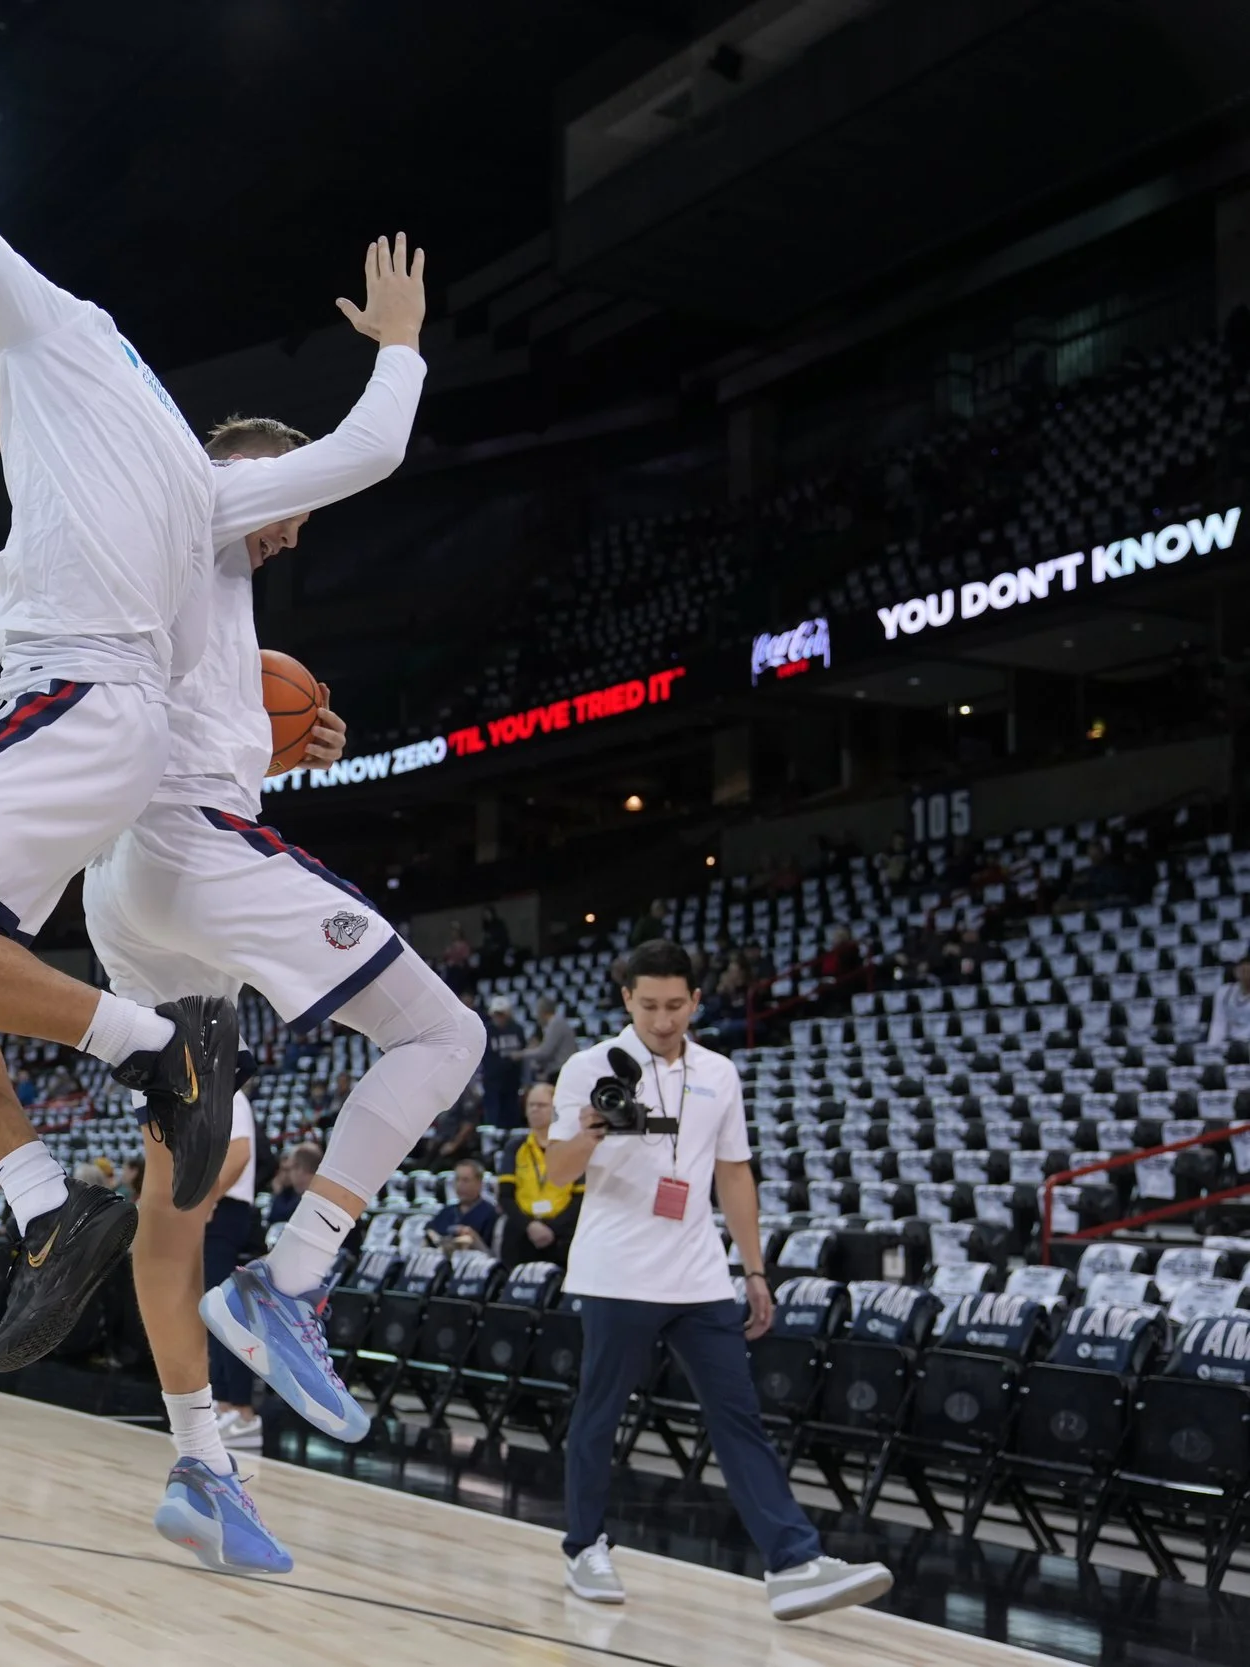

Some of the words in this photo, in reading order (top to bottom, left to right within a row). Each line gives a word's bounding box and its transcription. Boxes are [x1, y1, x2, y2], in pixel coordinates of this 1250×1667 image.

[877, 589, 954, 639] YOU
[961, 552, 1084, 619] DON'T
[1091, 507, 1241, 583] KNOW
[310, 751, 392, 788] KNOW
[392, 737, 447, 775] ZERO
[486, 702, 571, 748] YOU'VE
[574, 682, 646, 724] TRIED
[911, 789, 970, 842] 105
